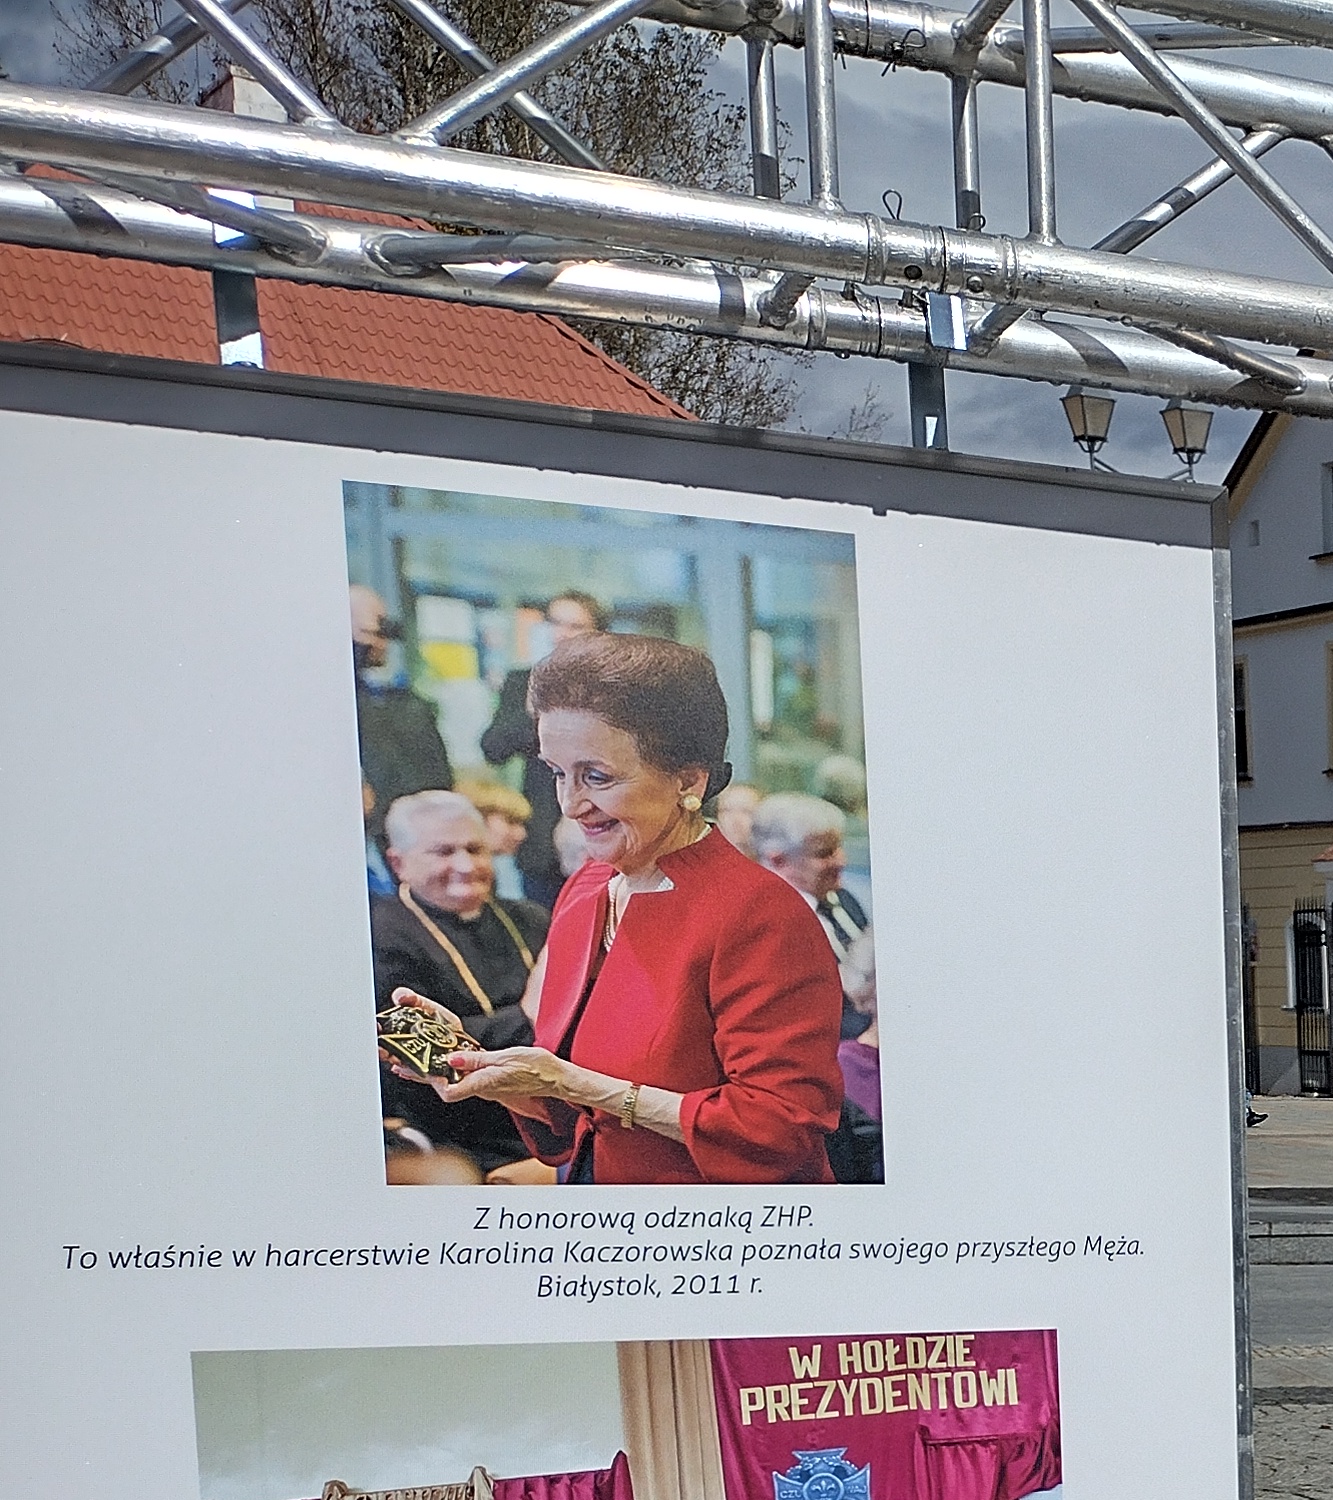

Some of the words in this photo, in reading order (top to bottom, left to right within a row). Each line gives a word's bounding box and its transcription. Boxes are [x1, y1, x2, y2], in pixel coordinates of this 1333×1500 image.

[473, 1207, 491, 1230] Z
[499, 1207, 635, 1235] honorową
[644, 1206, 752, 1234] odznaką
[760, 1205, 813, 1227] ZHP.
[63, 1246, 98, 1269] To
[108, 1245, 223, 1269] właśnie
[232, 1250, 256, 1267] w
[266, 1243, 430, 1267] harcerstwie
[440, 1241, 554, 1265] Karolina
[564, 1239, 733, 1263] Kaczorowska
[741, 1238, 841, 1267] poznała
[849, 1237, 948, 1265] swojego
[956, 1236, 1076, 1264] przyszłego
[1084, 1235, 1144, 1262] Męża.
[537, 1273, 661, 1304] Białystok,
[671, 1275, 740, 1295] 2011
[750, 1278, 762, 1293] r.
[789, 1344, 822, 1379] W
[838, 1334, 976, 1376] HOŁDZIE
[739, 1368, 1018, 1426] PREZYDENTOWI
